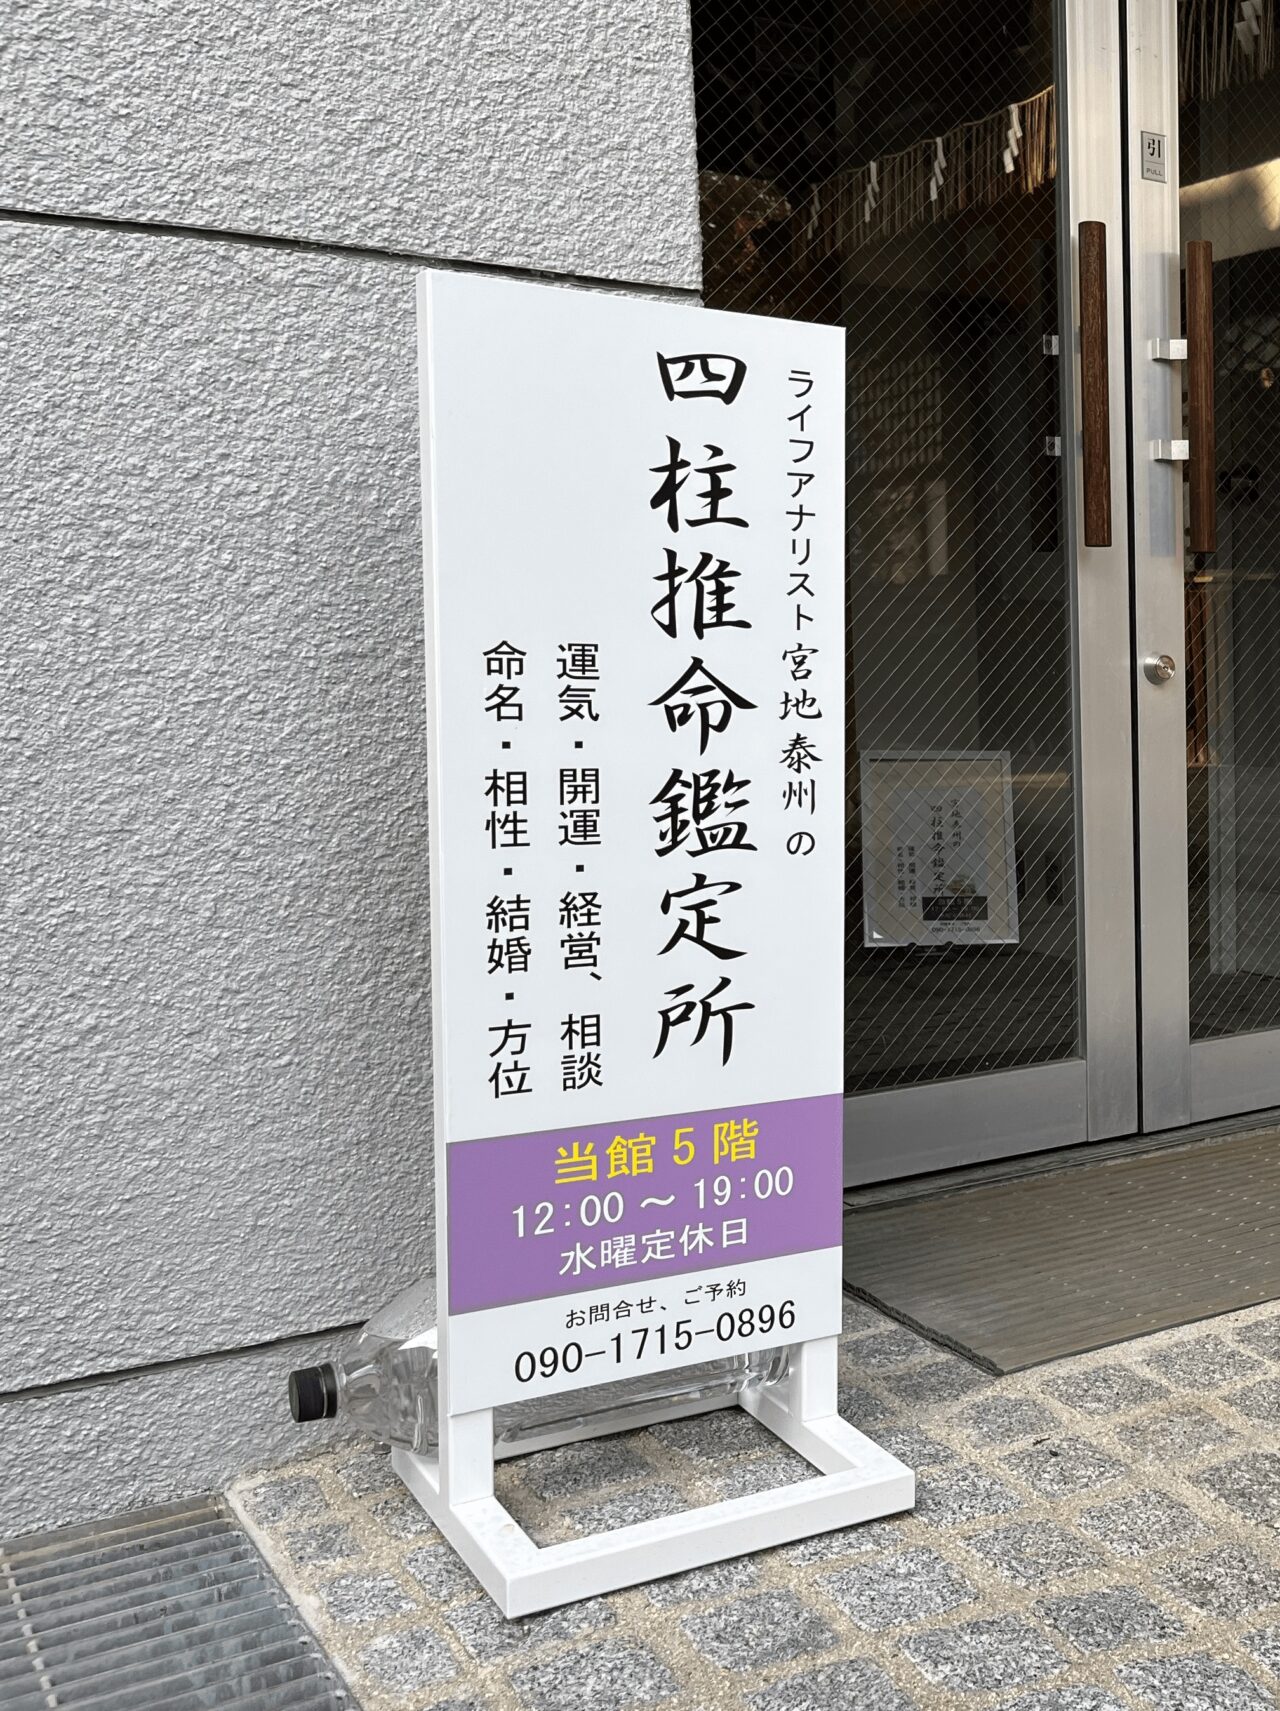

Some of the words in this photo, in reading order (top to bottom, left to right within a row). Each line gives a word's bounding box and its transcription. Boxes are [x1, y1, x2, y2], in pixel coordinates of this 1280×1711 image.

[1146, 168, 1163, 177] PULL
[1147, 138, 1161, 158] 引
[778, 370, 823, 856] ライフアナリスト宮地泰州の
[647, 351, 759, 1066] 四柱推命鑑定所
[559, 1218, 748, 1276] 水曜定休日
[514, 1300, 796, 1383] 090-1715-0896
